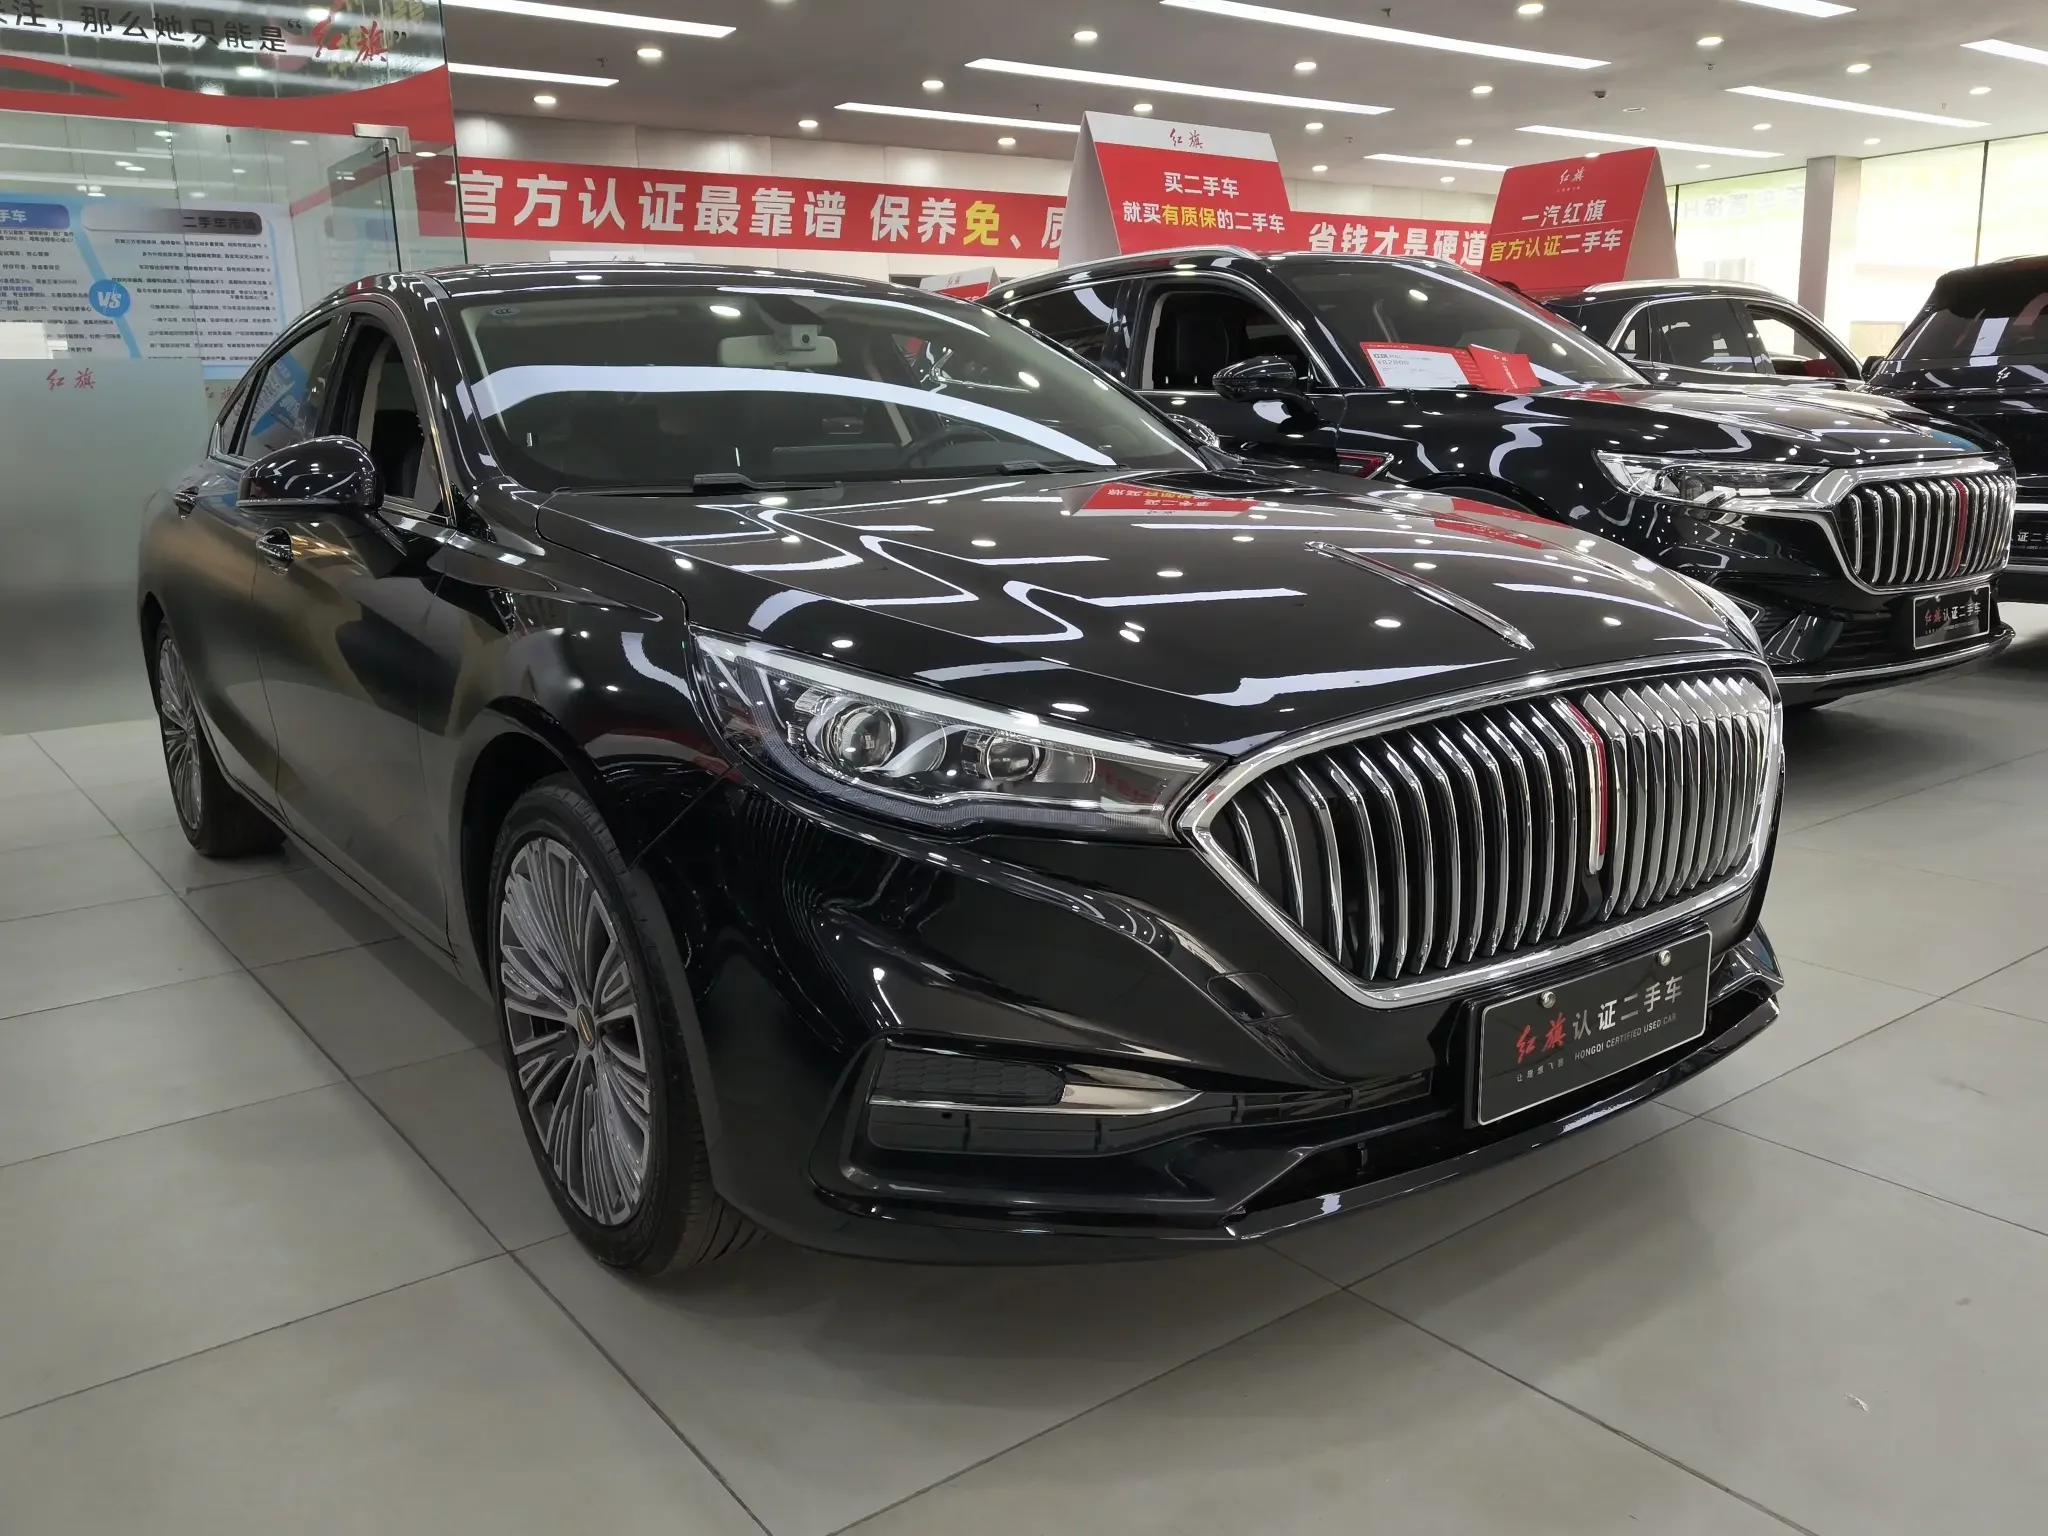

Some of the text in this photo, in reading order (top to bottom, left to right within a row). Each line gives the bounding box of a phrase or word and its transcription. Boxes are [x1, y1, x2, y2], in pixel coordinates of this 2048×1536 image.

[0, 0, 407, 63] 注，那么她只能是“红旗”
[1169, 128, 1204, 149] 红旗
[1164, 171, 1240, 199] 买二手车
[1559, 166, 1585, 185] 红旗
[452, 169, 846, 239] 官方认证最靠谱
[1122, 200, 1286, 234] 就买有质保的二手车
[1522, 199, 1607, 229] 一汽红旗
[1490, 228, 1623, 263] 官方认证二手车
[46, 368, 96, 391] 红旗
[1516, 975, 1683, 1064] 红旗认证二手车
[1574, 1012, 1677, 1061] HONGQI CERTIFIED USED CAR
